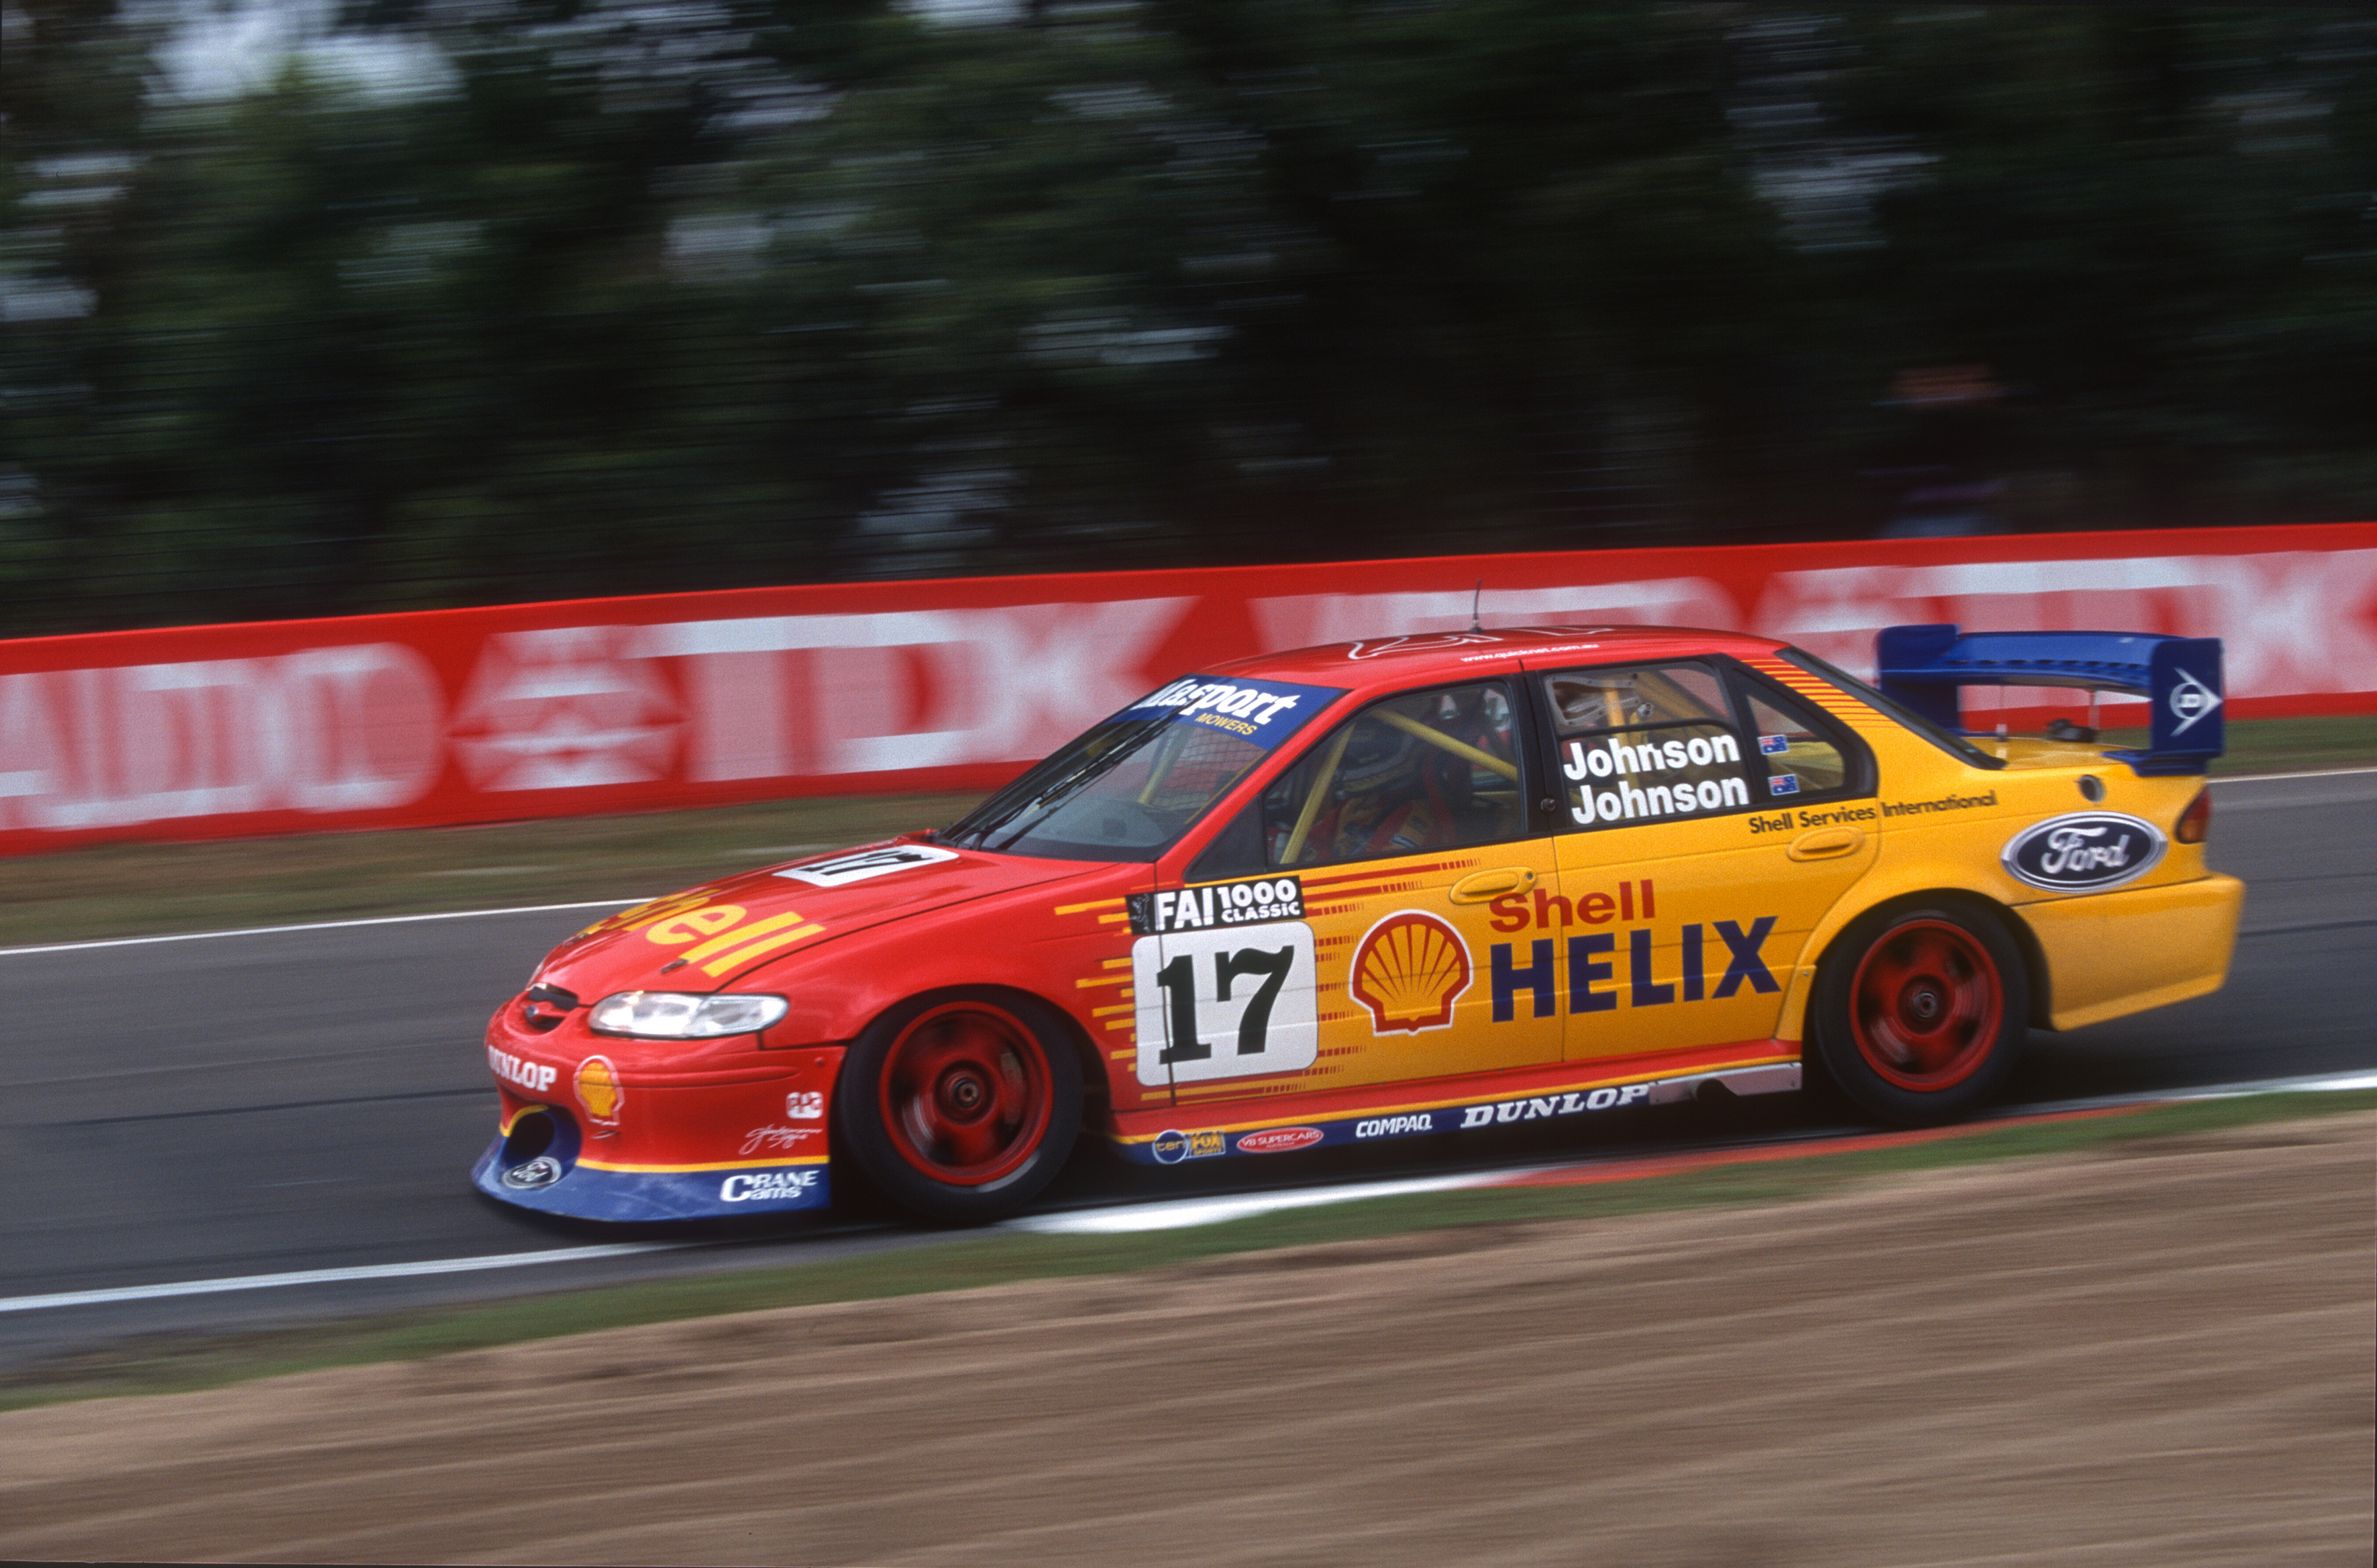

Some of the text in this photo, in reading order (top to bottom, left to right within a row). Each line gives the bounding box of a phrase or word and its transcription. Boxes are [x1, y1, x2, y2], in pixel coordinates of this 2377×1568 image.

[619, 594, 1204, 785] TDK
[1194, 713, 1258, 735] MOWERS
[1563, 734, 1741, 780] Johnson
[1571, 777, 1750, 825] Johnson
[1748, 789, 1998, 834] Shell Services International
[2040, 826, 2130, 874] Ford
[1154, 879, 1298, 931] FAI 1000
[1488, 879, 1655, 933] Shell
[1489, 915, 1782, 1024] HELIX
[1157, 945, 1295, 1065] 17
[1355, 1114, 1433, 1138] COMPAQ
[1460, 1084, 1650, 1129] DUNLOP
[1257, 1131, 1320, 1145] SUPERCARS
